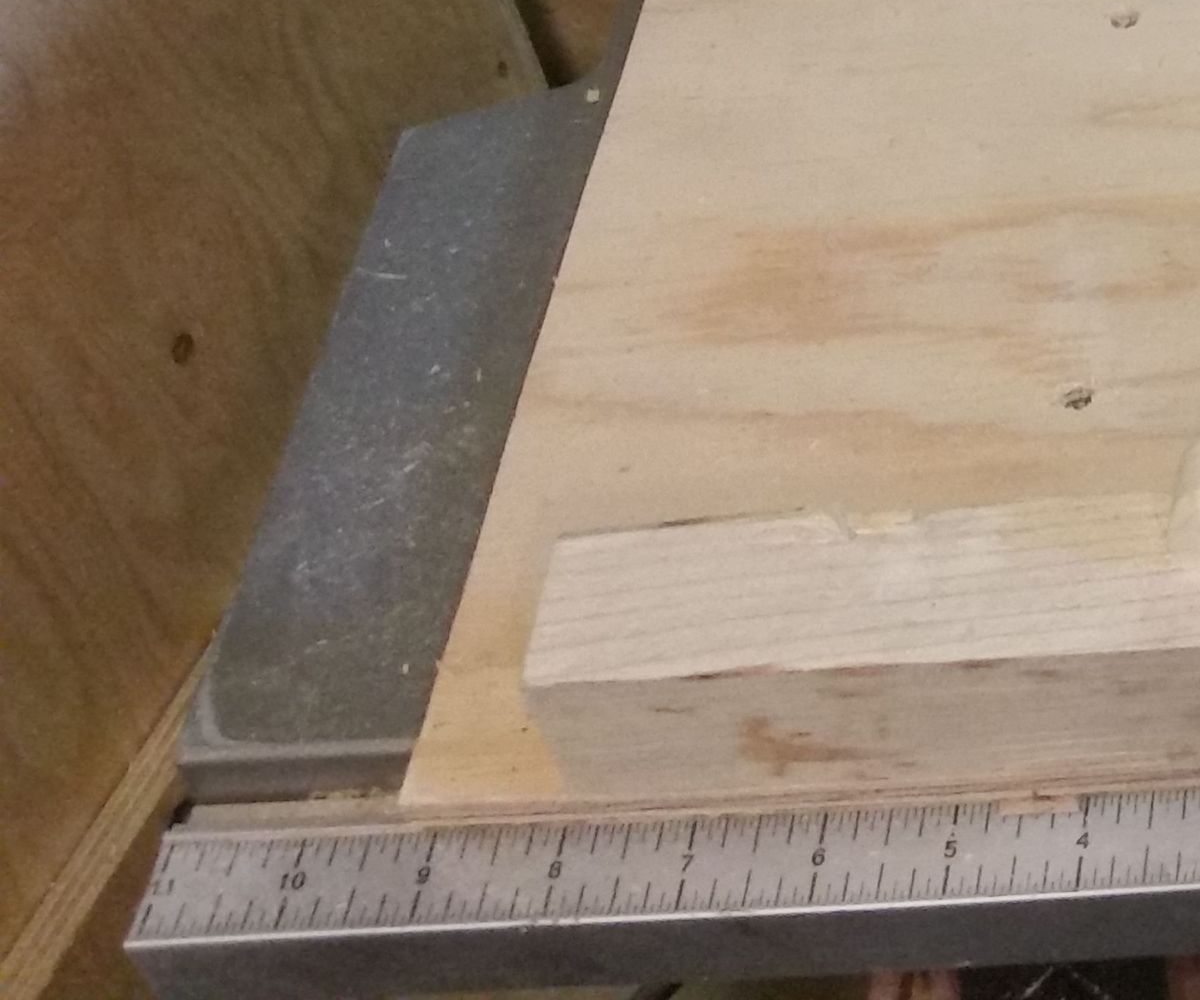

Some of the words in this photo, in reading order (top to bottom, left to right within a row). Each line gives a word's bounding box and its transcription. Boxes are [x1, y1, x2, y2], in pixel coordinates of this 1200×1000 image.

[279, 871, 307, 890] 10
[416, 865, 431, 884] 9
[548, 860, 562, 879] 8
[681, 853, 695, 873] 7
[811, 848, 826, 866] 6
[943, 840, 957, 859] 5
[1076, 832, 1090, 849] 4
